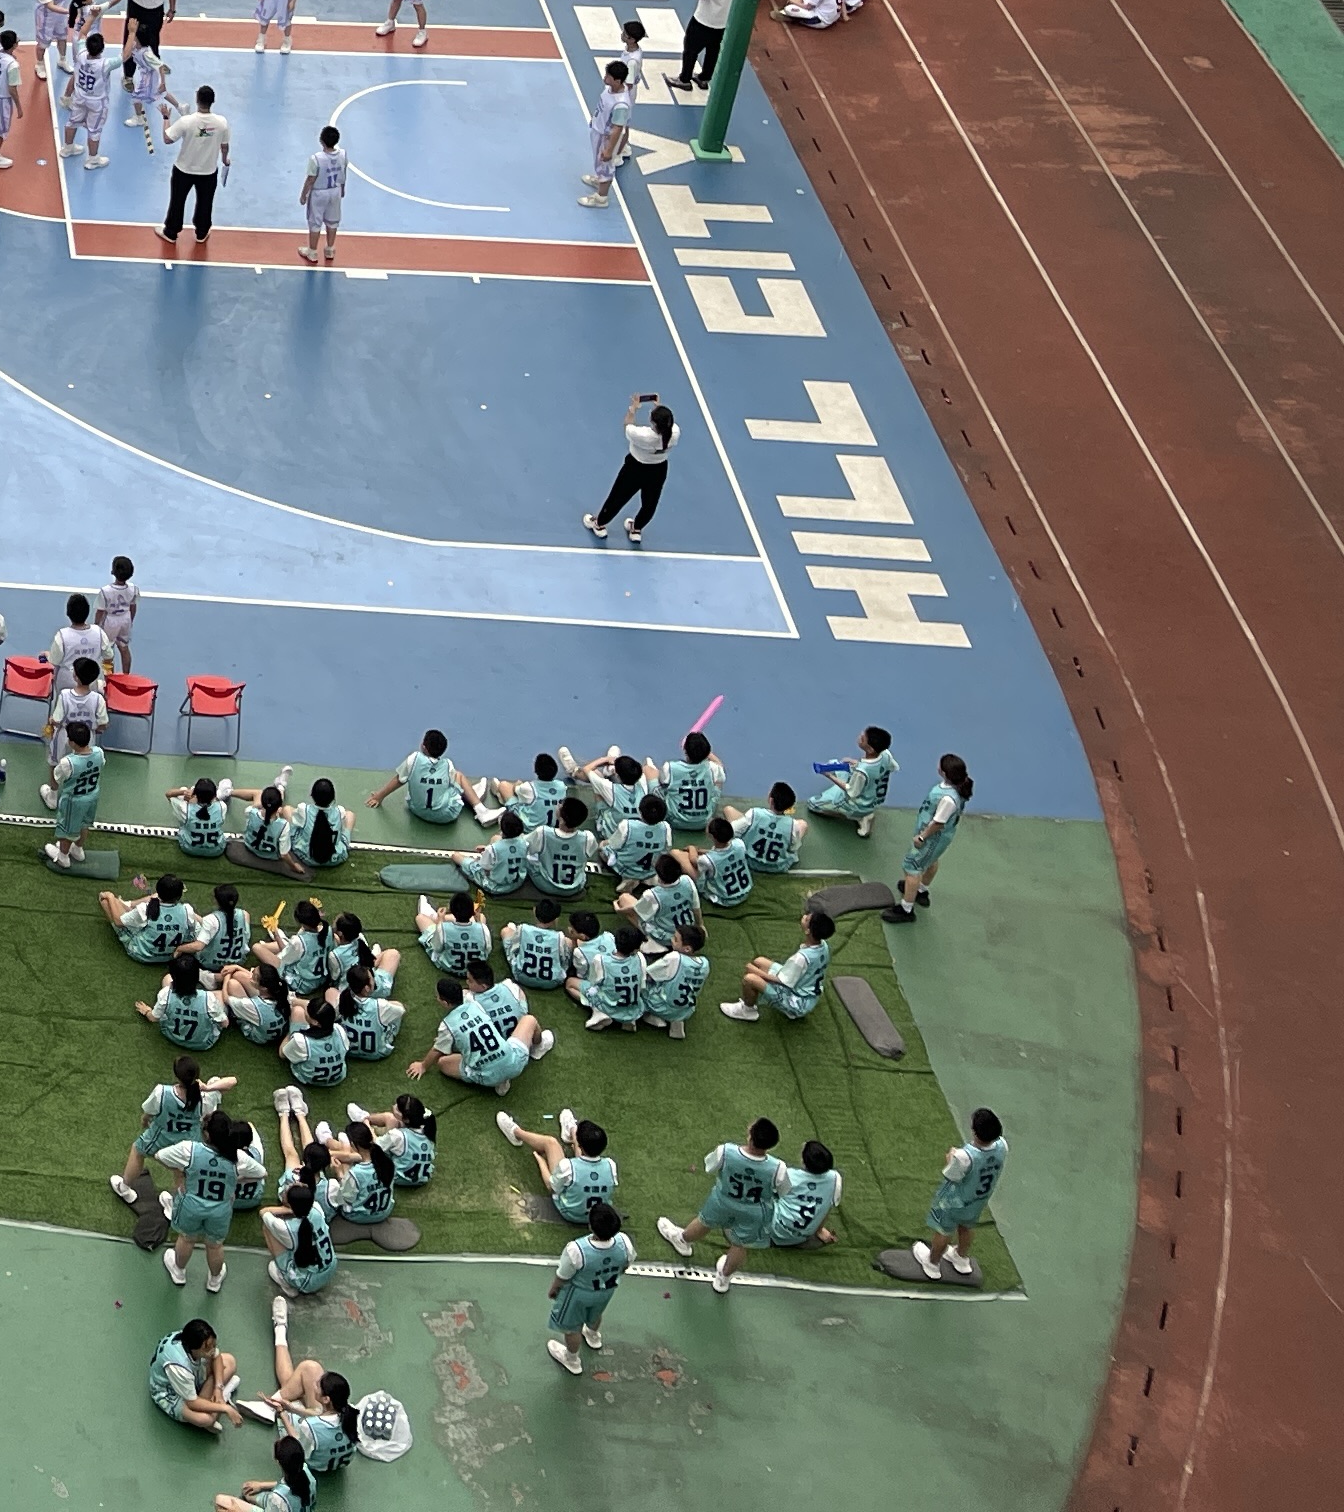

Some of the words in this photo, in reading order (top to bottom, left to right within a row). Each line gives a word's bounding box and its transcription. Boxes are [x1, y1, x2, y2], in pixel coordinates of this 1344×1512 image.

[744, 380, 973, 649] HILL
[74, 773, 100, 795] 29
[426, 788, 434, 809] 1
[679, 788, 708, 810] 30
[637, 853, 653, 870] 4
[752, 840, 783, 862] 46
[552, 863, 576, 885] 13
[723, 871, 749, 895] 26
[153, 933, 182, 952] 44
[217, 941, 243, 959] 32
[522, 954, 553, 980] 28
[615, 986, 638, 1007] 31
[172, 1018, 197, 1040] 17
[470, 1024, 499, 1056] 48
[350, 1031, 375, 1054] 20
[312, 1064, 344, 1081] 22
[197, 1179, 226, 1202] 19
[728, 1173, 762, 1203] 34
[975, 1177, 991, 1195] 3
[363, 1192, 391, 1216] 40
[794, 1207, 813, 1230] 5
